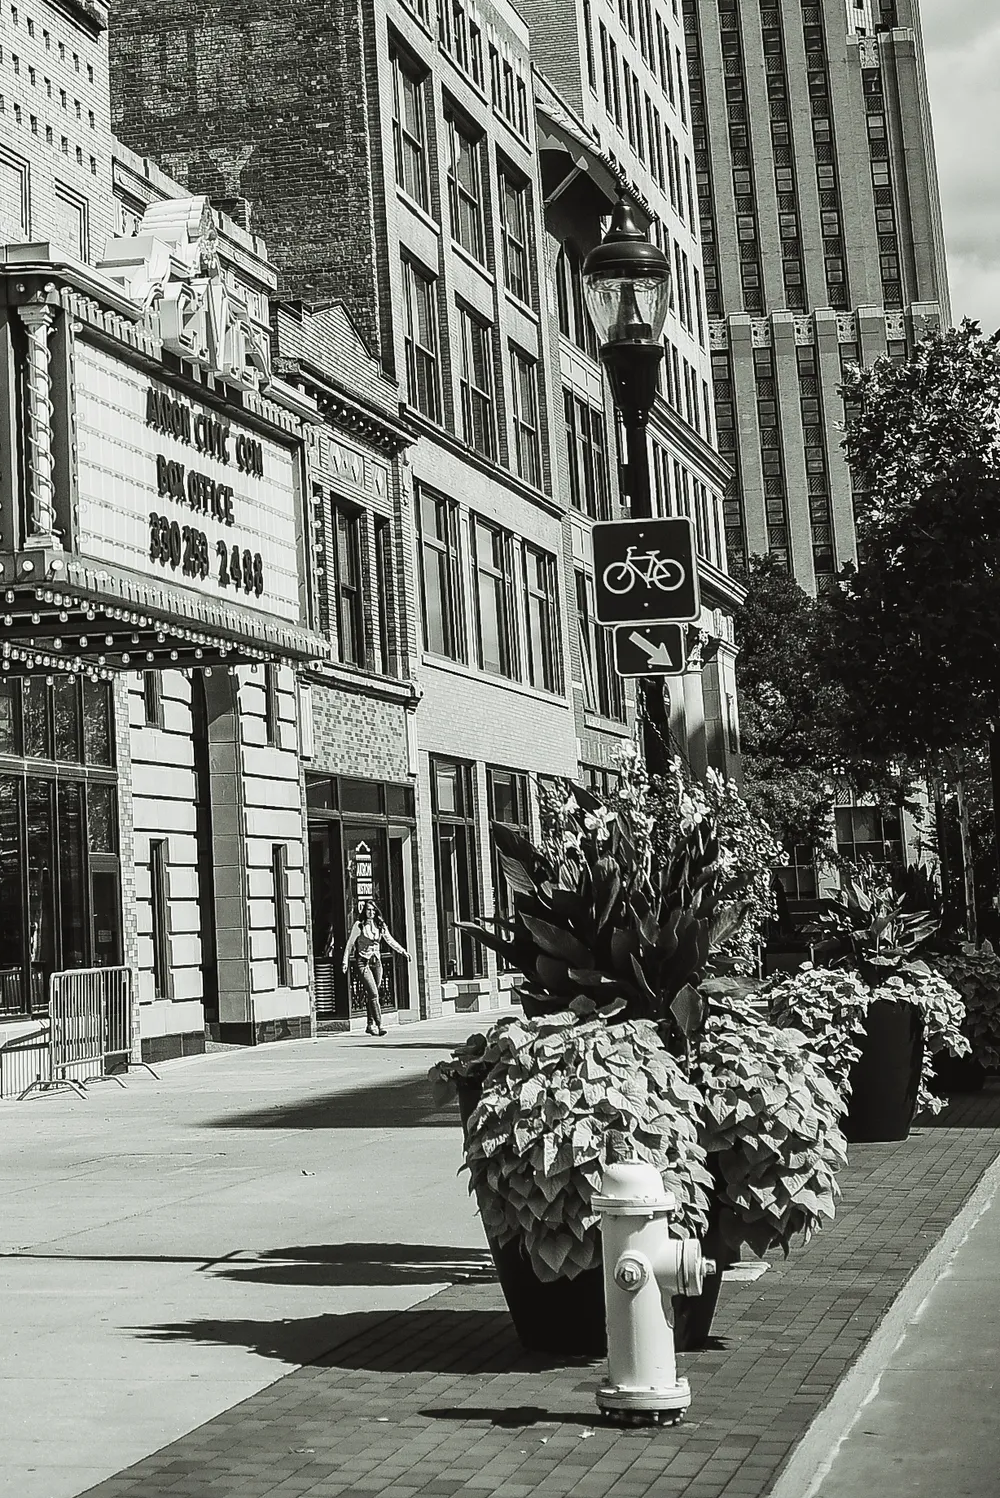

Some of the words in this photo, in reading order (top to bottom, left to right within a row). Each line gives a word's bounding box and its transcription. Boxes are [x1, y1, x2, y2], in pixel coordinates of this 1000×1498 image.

[146, 386, 191, 447] AKRON
[193, 412, 231, 466] CIVIC
[234, 433, 264, 481] COM
[156, 453, 187, 507] BOX
[187, 469, 235, 527] OFFICE
[150, 511, 181, 572] 330
